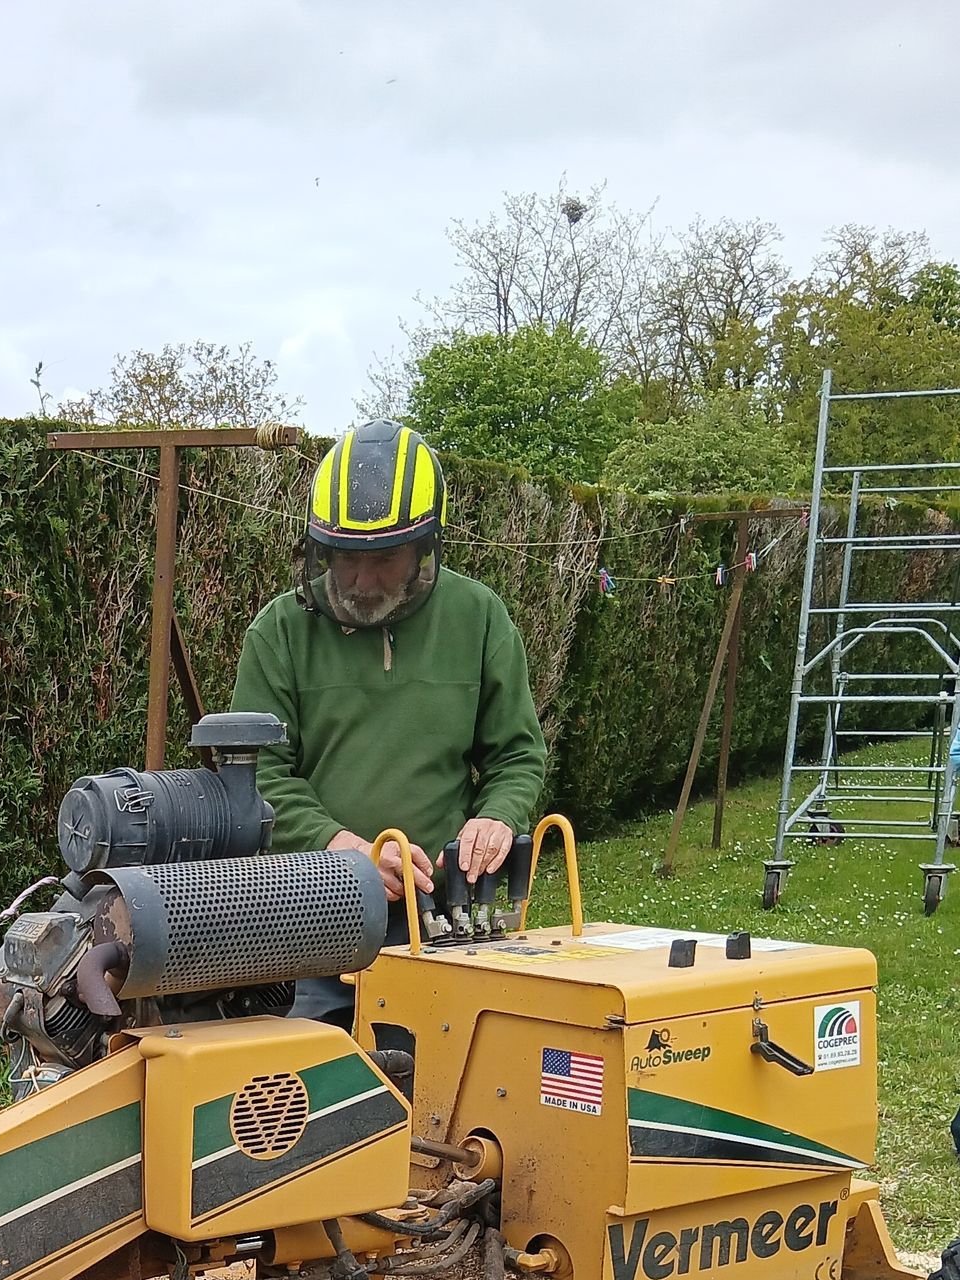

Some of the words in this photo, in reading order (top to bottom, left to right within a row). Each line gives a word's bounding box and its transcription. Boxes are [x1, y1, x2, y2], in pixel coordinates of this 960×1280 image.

[818, 1035, 857, 1050] COGEPREC
[631, 1046, 711, 1071] AutoSweep
[544, 1096, 567, 1107] MADE
[570, 1101, 578, 1110] IN
[580, 1103, 597, 1114] USA
